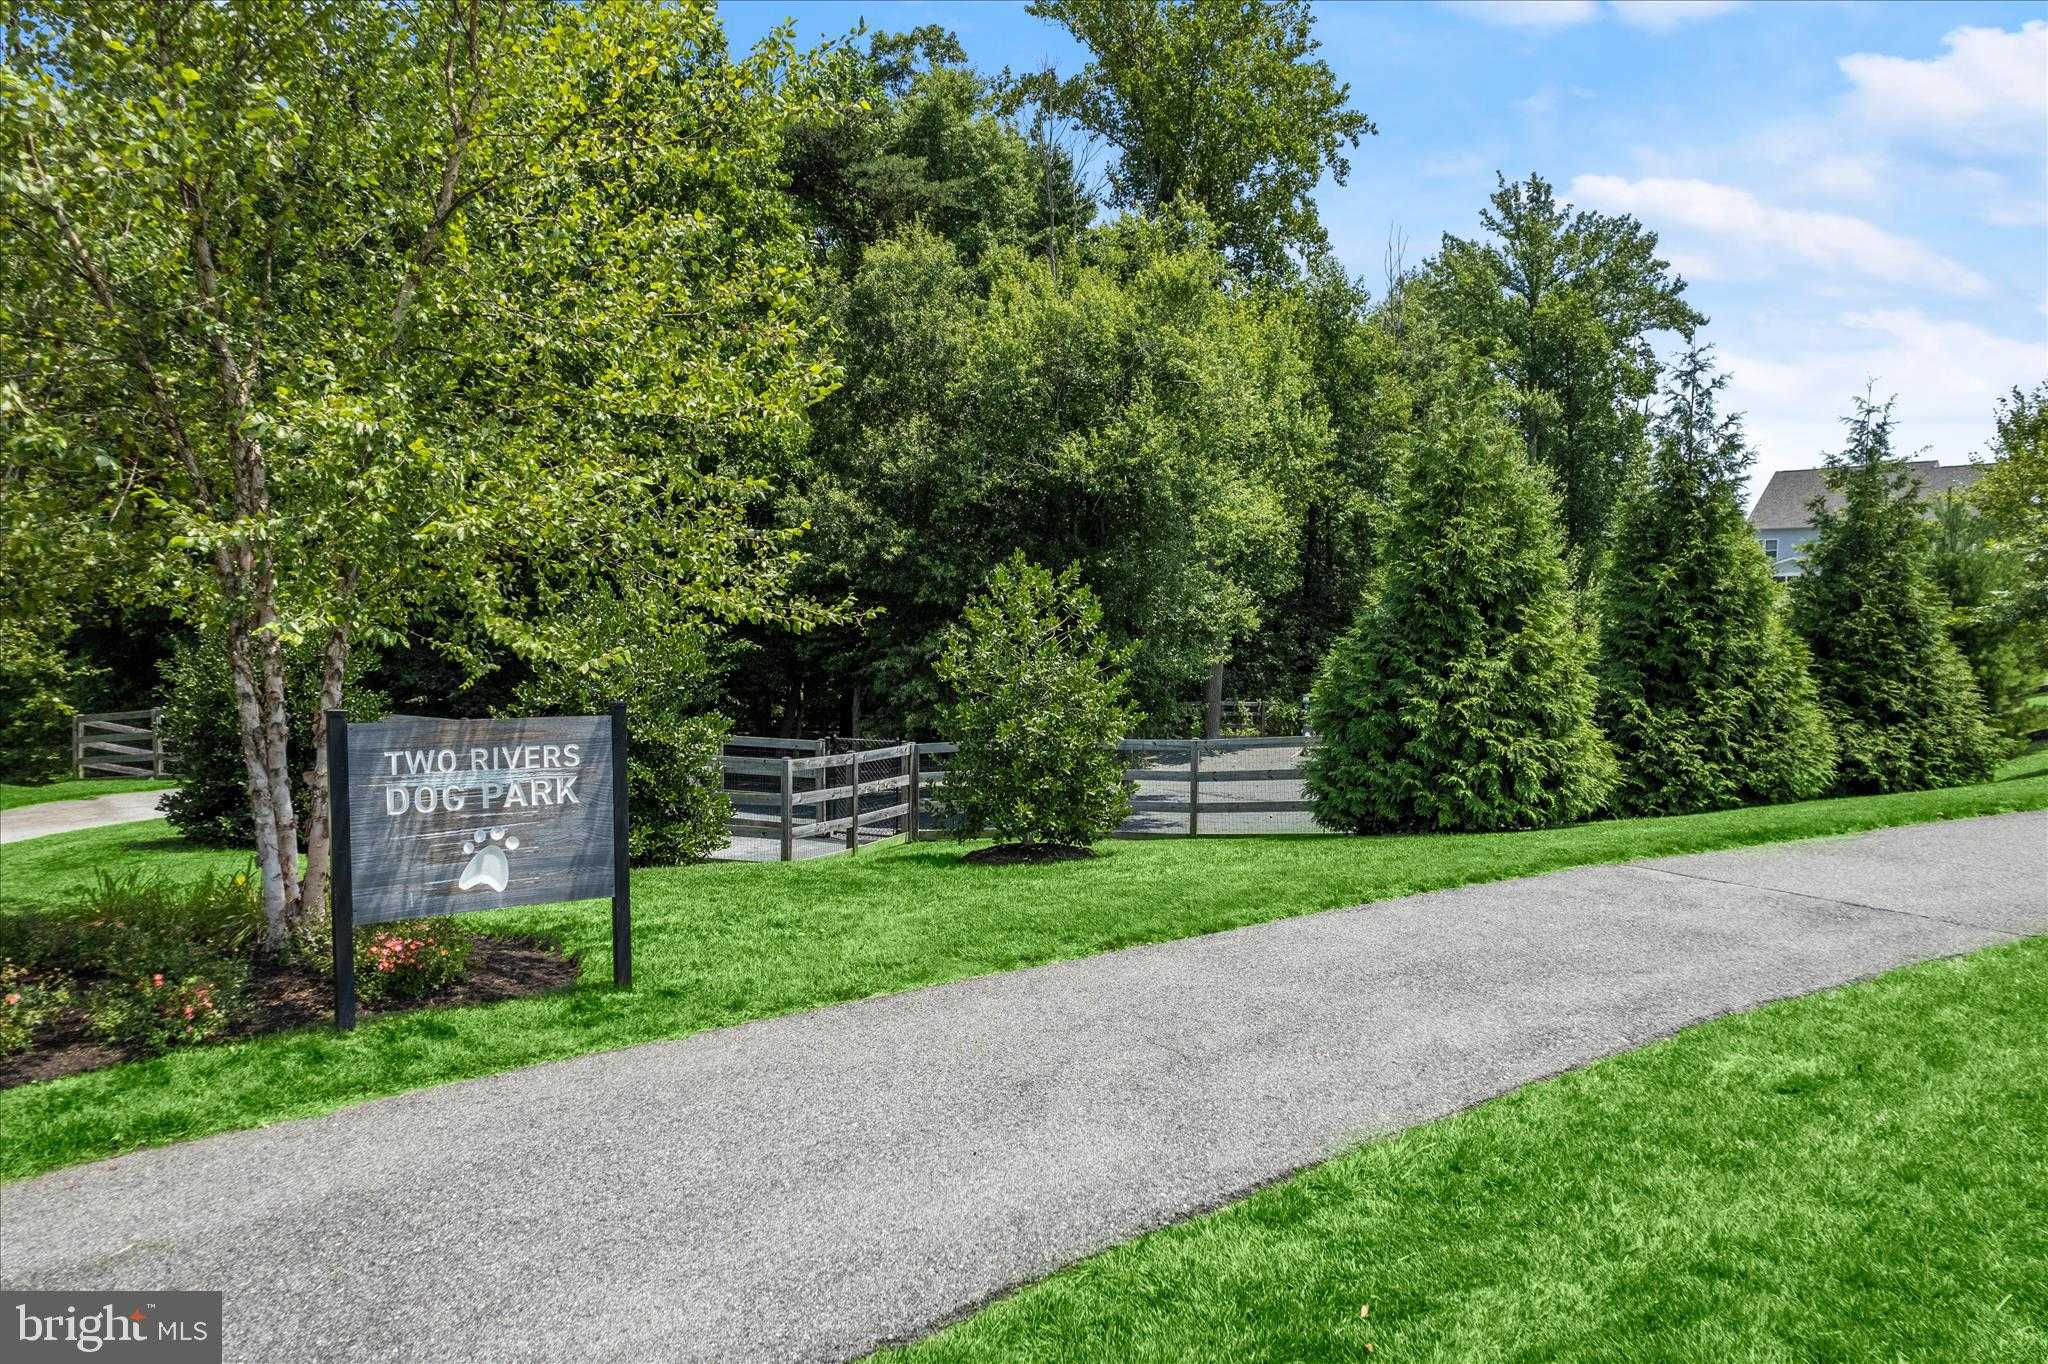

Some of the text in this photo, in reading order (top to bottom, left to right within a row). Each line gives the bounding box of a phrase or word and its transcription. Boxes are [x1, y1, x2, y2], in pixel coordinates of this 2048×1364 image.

[384, 744, 580, 776] TWO RIVERS
[386, 776, 580, 816] DOG PARK
